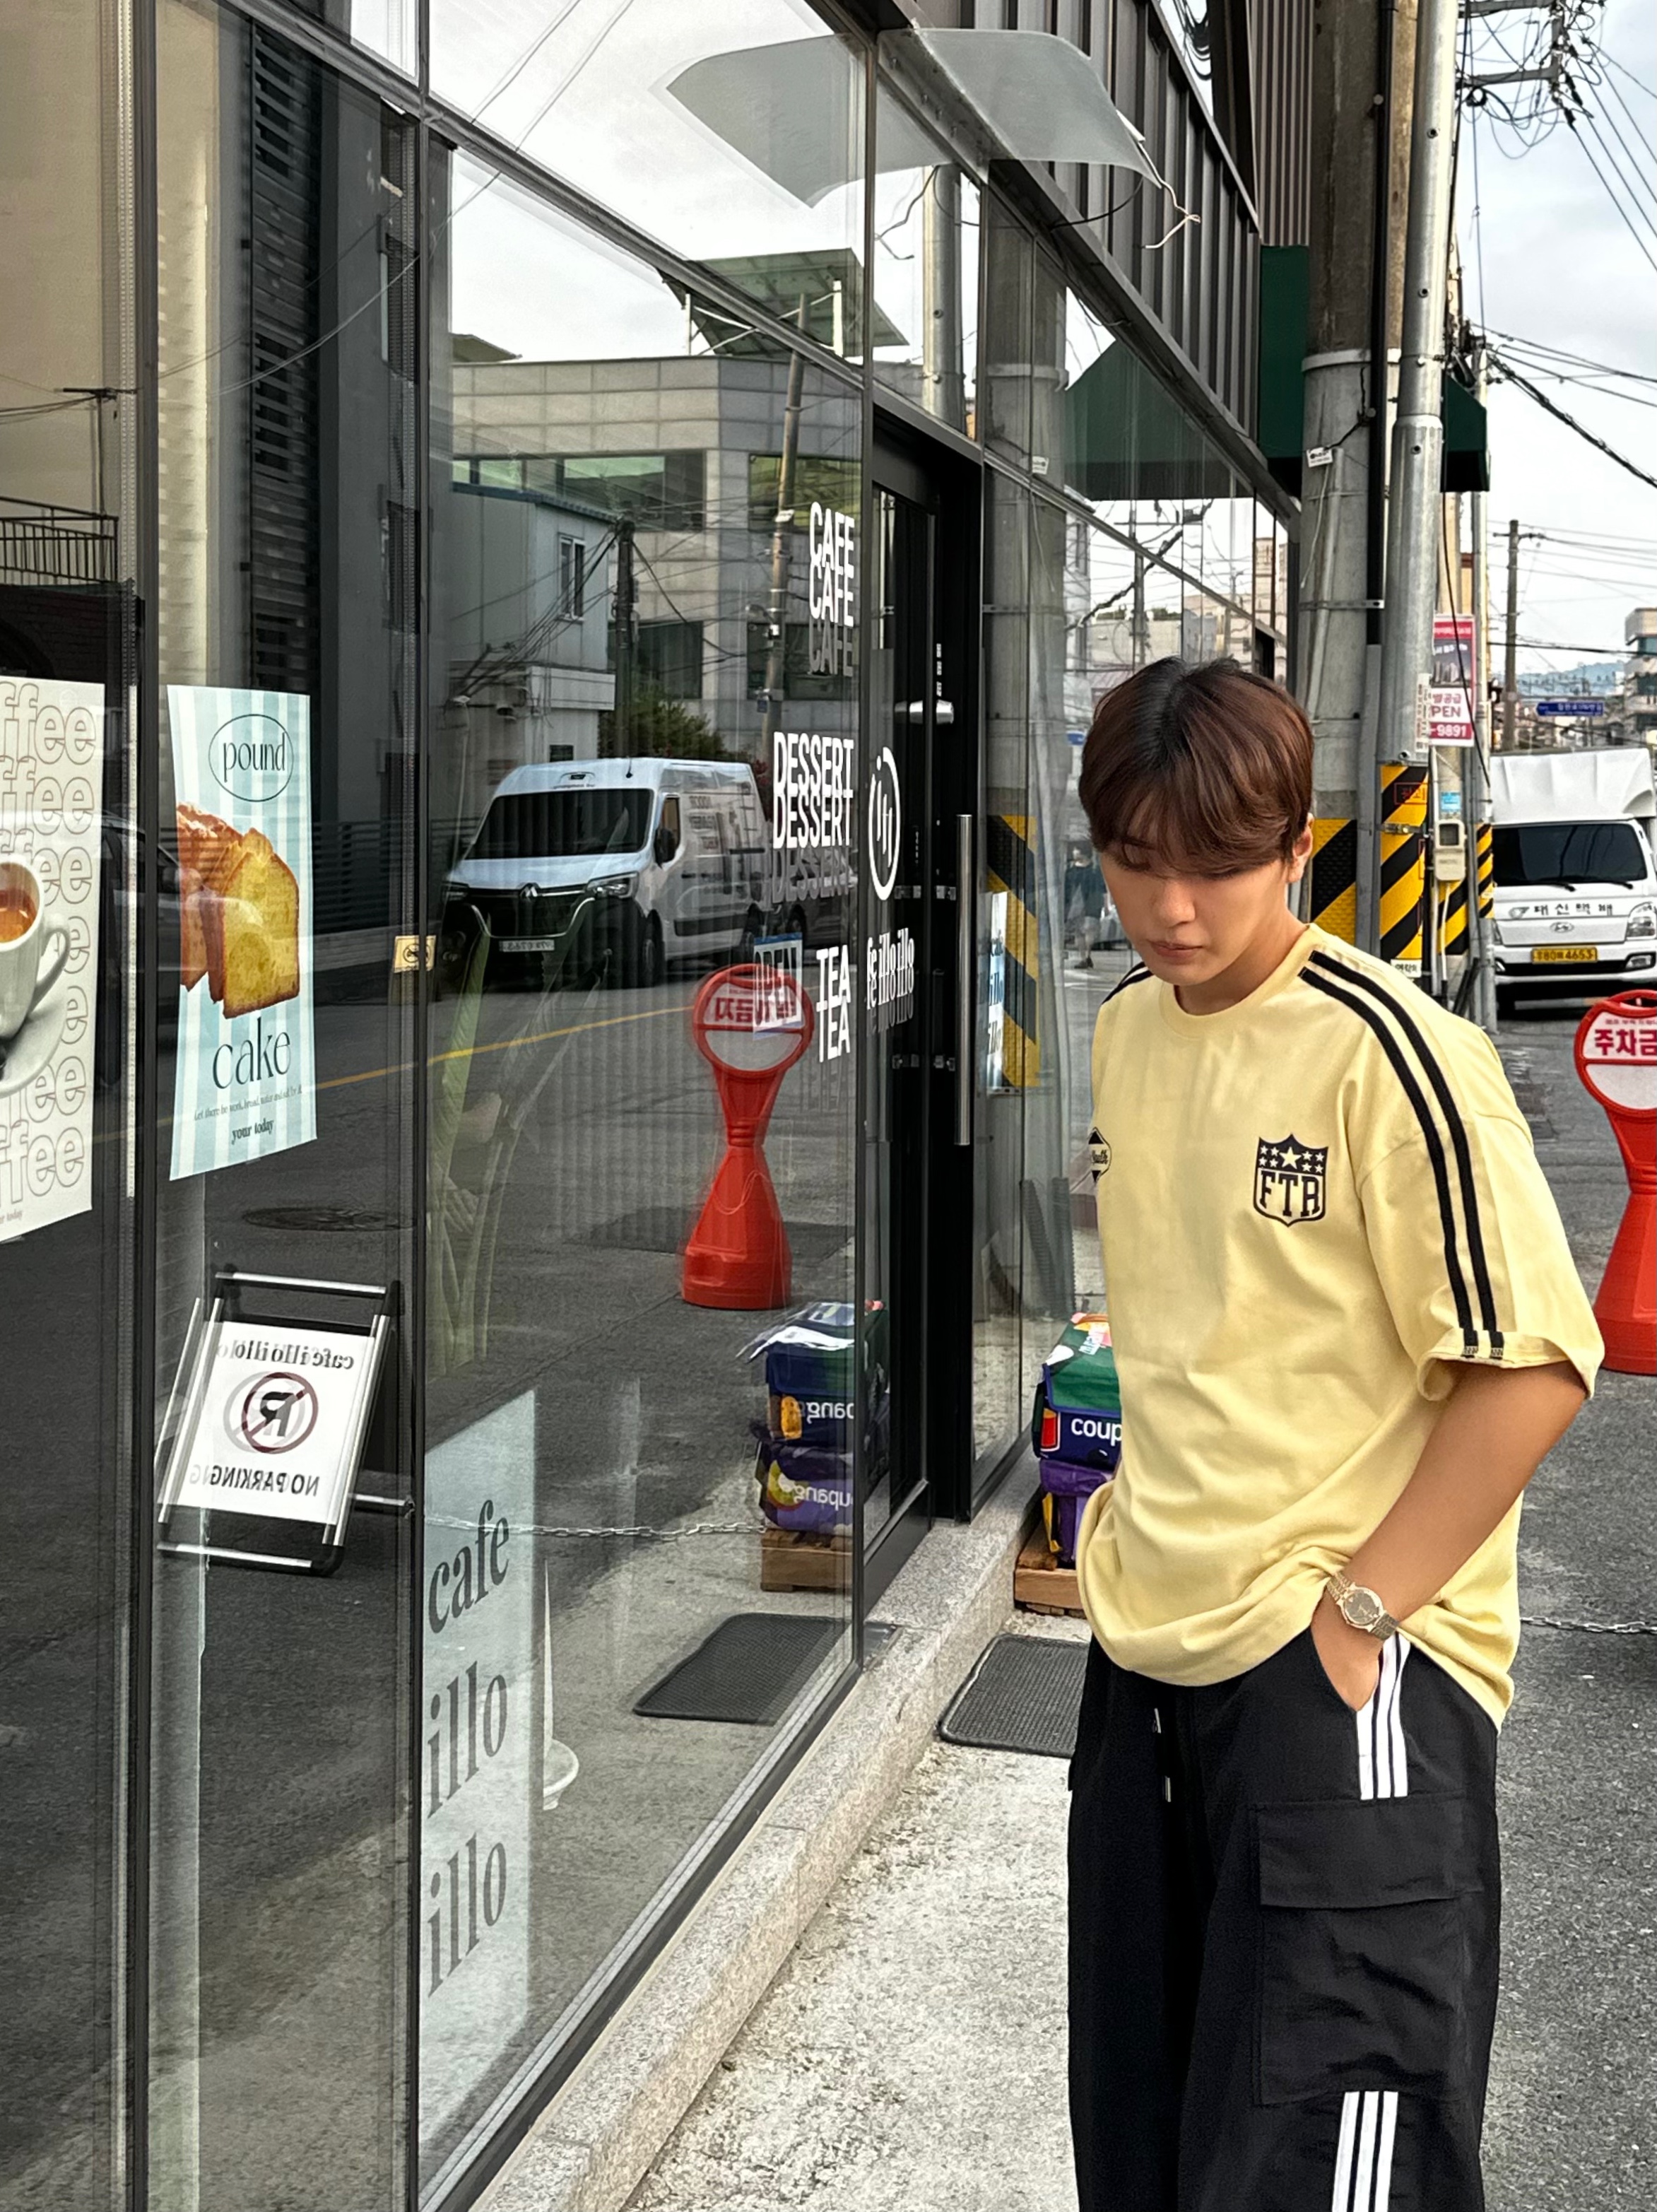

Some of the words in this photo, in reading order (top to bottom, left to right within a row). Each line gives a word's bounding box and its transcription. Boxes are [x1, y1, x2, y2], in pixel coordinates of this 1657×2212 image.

[810, 502, 855, 578] CAFE
[810, 561, 854, 627] CAFE
[223, 732, 285, 782] pound
[773, 731, 854, 797] DESSERT
[773, 789, 852, 848] DESSERT
[816, 945, 851, 1012] TEA
[213, 1016, 291, 1089] cake
[816, 996, 850, 1063] TEA
[232, 1126, 252, 1145] your
[254, 1117, 274, 1135] today
[428, 1499, 510, 1634] cafe
[427, 1660, 508, 1820] illo
[427, 1832, 507, 1998] illo
